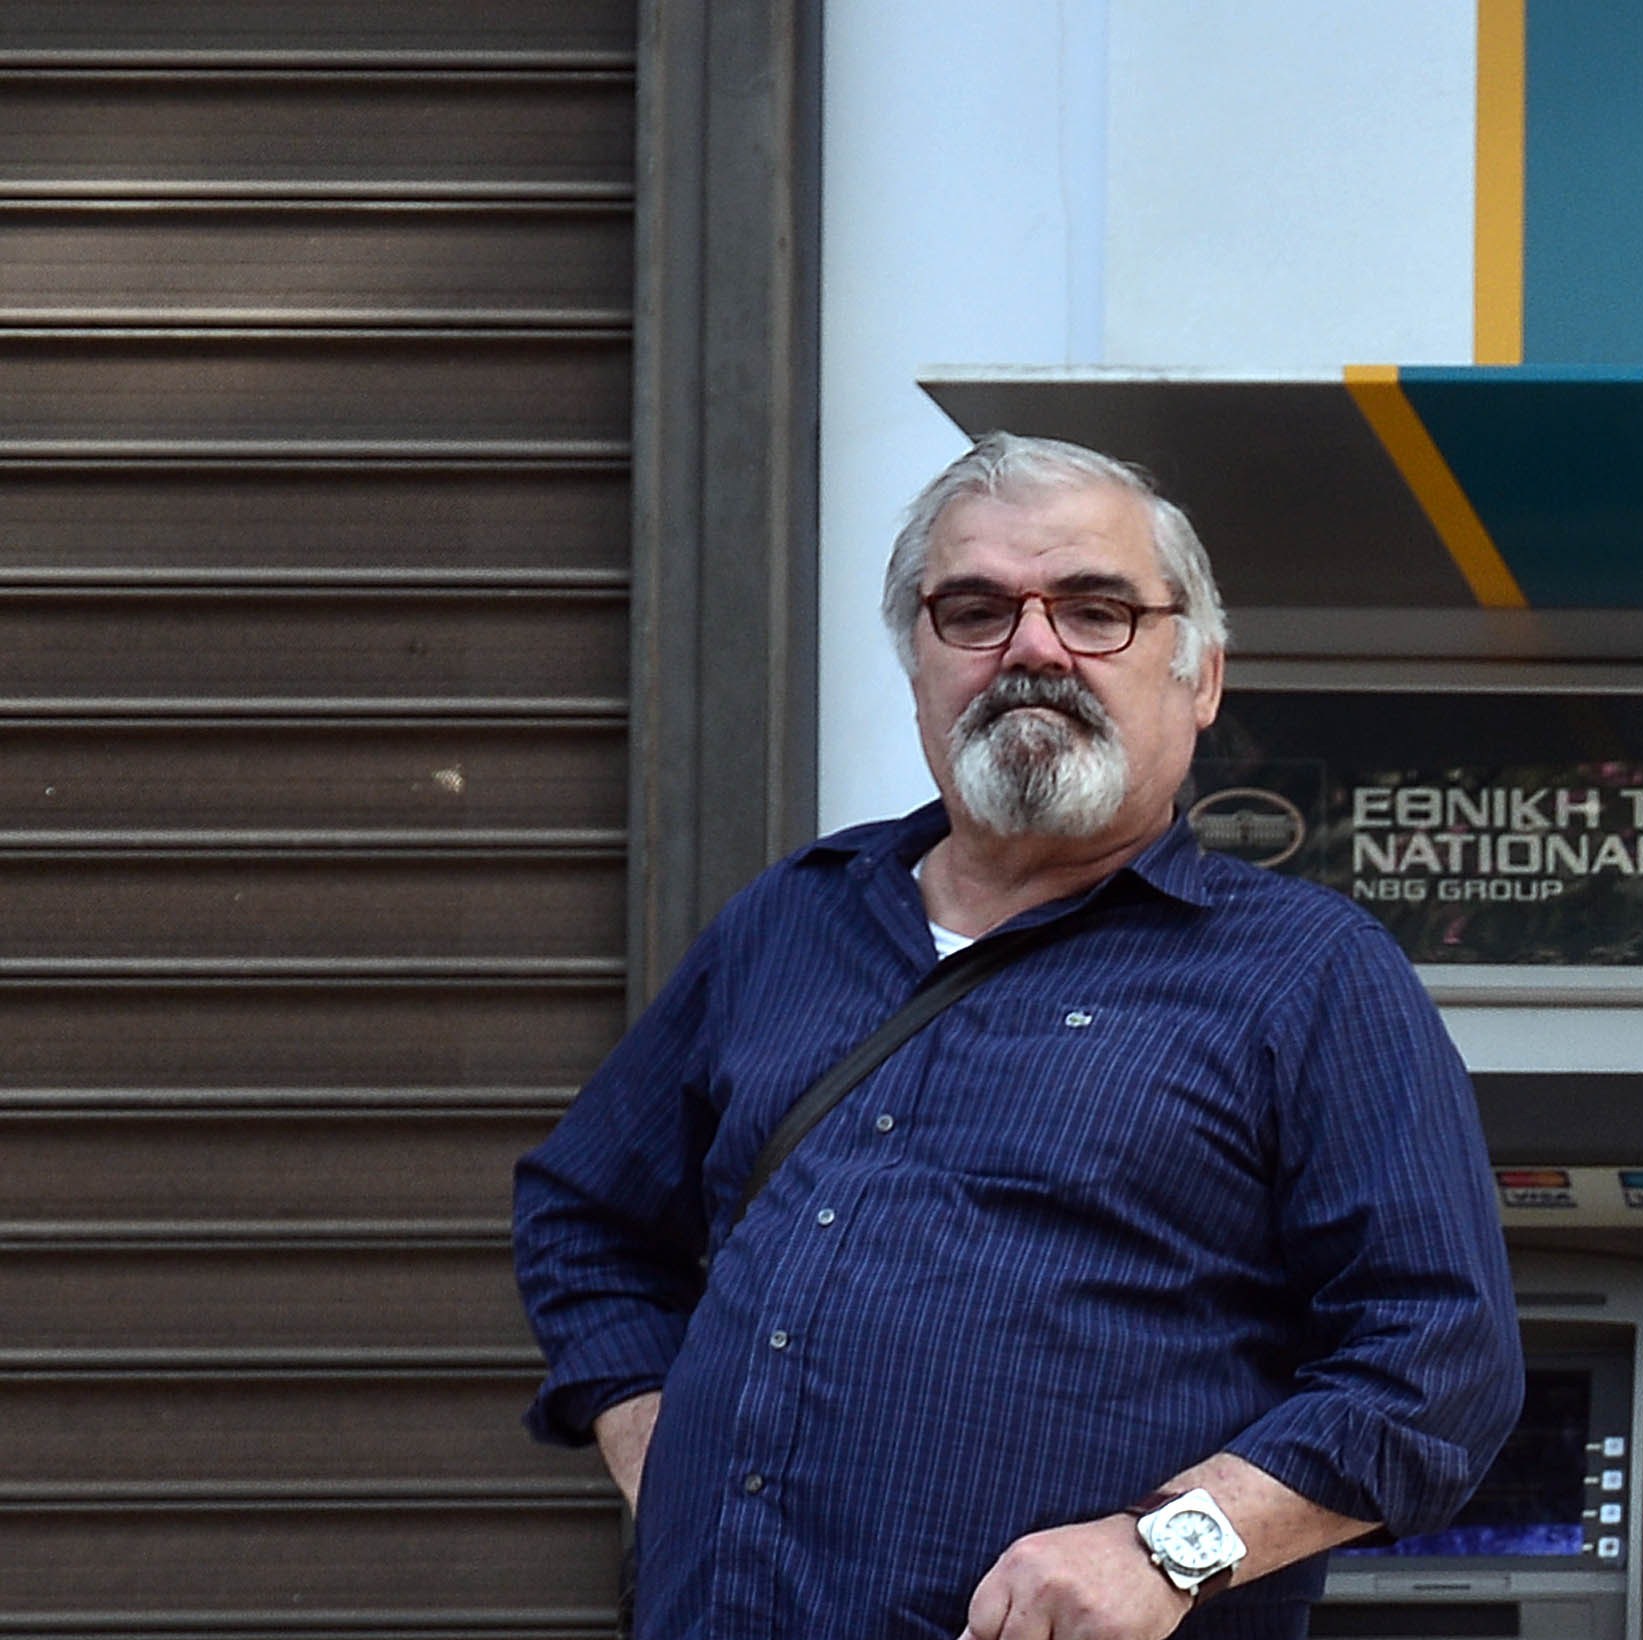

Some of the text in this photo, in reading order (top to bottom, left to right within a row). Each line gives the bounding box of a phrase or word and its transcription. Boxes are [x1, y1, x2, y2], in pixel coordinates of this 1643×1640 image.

[1353, 788, 1600, 829] ΕΘΝΙΚΗ
[1353, 878, 1564, 901] NBG GROUP
